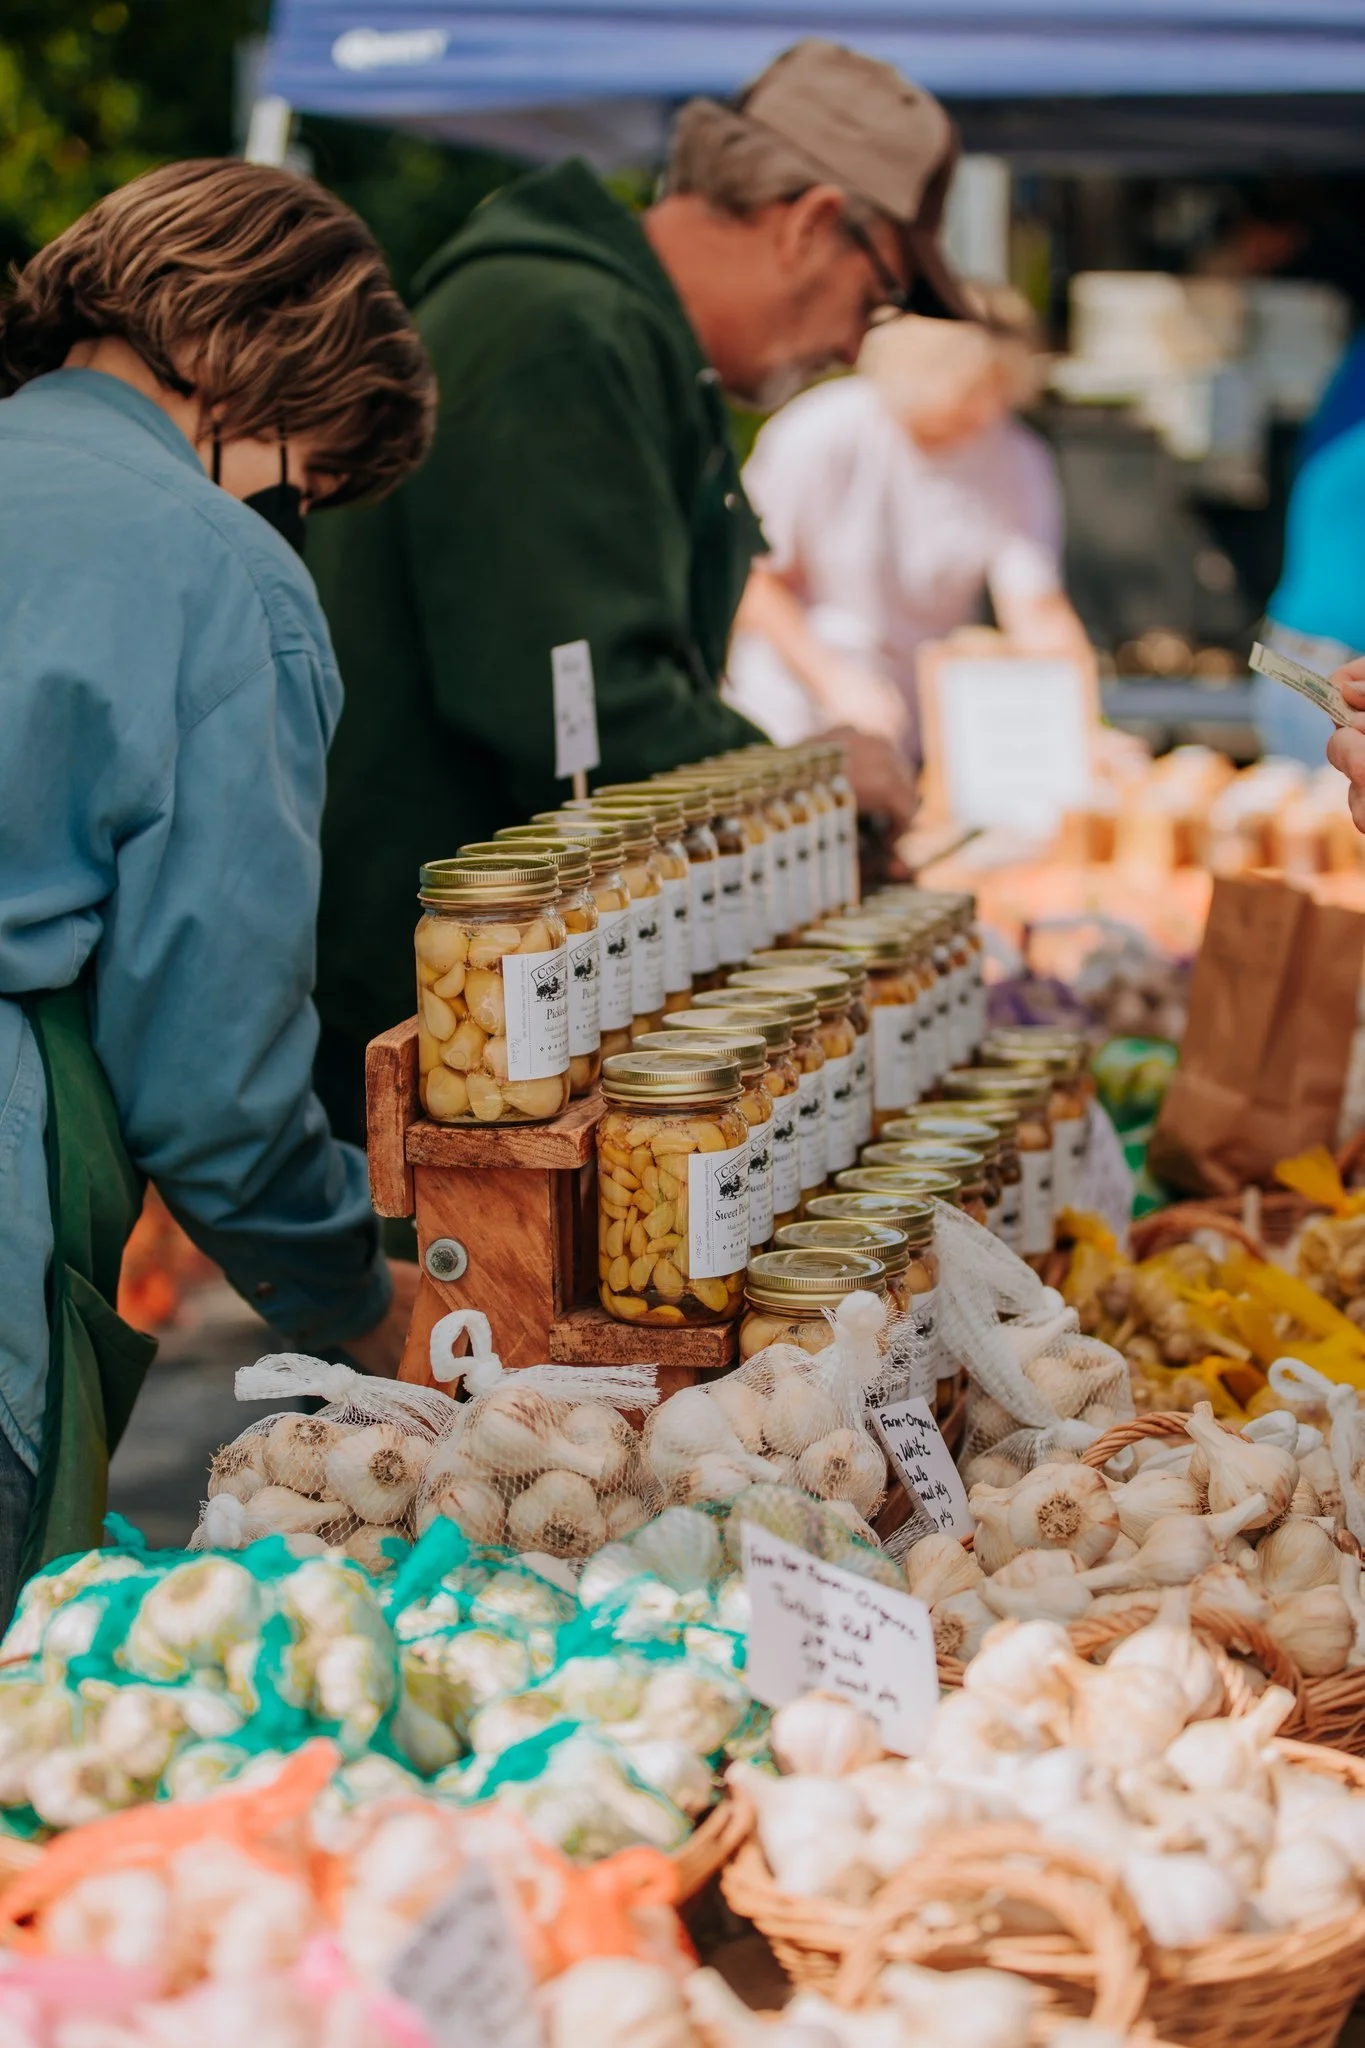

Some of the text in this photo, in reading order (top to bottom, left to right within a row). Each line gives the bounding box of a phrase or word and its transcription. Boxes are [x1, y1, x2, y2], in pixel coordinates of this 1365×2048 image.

[715, 1206, 738, 1221] Sweet
[917, 1484, 936, 1502] mall
[841, 1613, 872, 1642] Red
